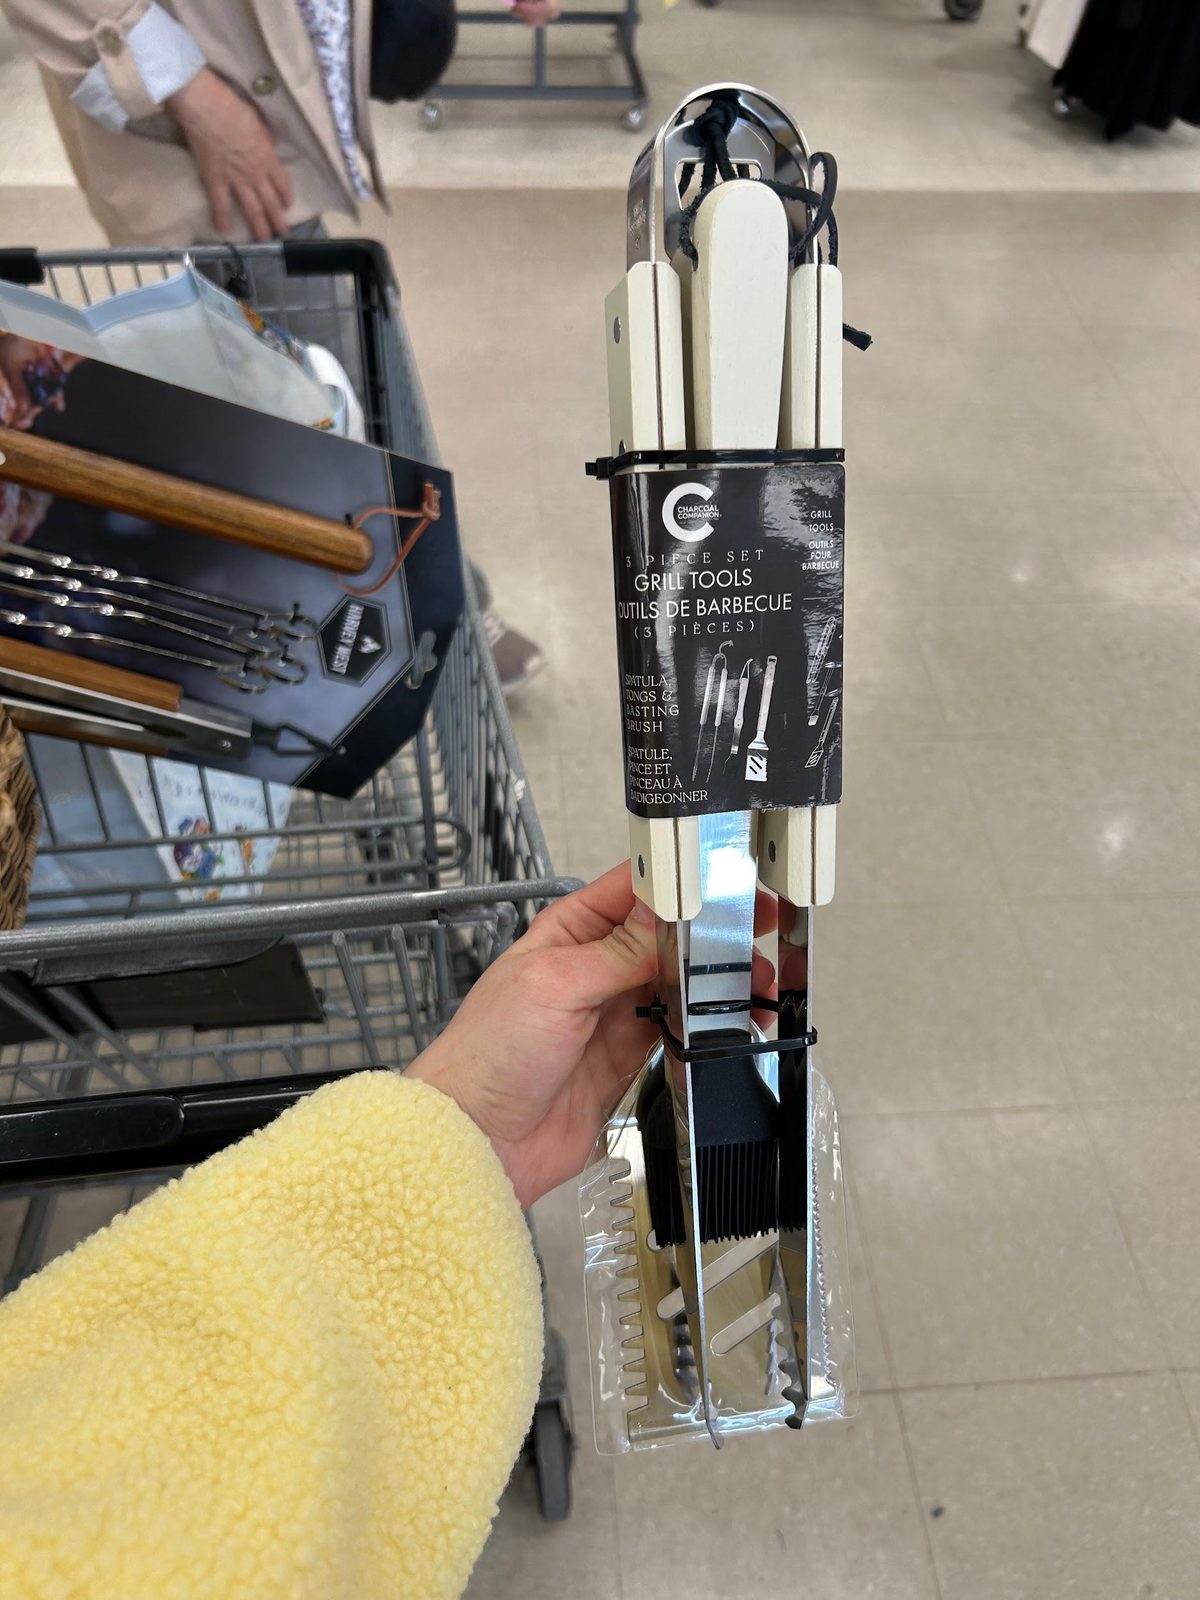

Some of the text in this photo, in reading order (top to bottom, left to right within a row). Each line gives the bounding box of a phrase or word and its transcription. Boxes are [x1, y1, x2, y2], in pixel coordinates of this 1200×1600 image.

[677, 504, 719, 514] CHARCOAL
[677, 511, 720, 520] COMPANION
[810, 510, 832, 519] GRILL
[809, 523, 834, 532] TOOLS
[809, 540, 834, 550] OUTILS
[625, 549, 764, 568] 3 PIECE SET
[810, 551, 832, 560] POUR
[802, 560, 840, 571] BARBECUE
[634, 568, 753, 592] GRILL TOOLS
[618, 593, 792, 620] OUTILS DE BARBECUE
[634, 620, 755, 640] (3 PIÈCES)
[625, 688, 673, 703] TONGS &
[626, 703, 680, 718] BASTING
[627, 718, 663, 733] BRUSH
[628, 745, 673, 761] SPATULE,
[655, 763, 672, 775] ET
[673, 774, 683, 789] À
[630, 788, 709, 805] BADIGEONNER
